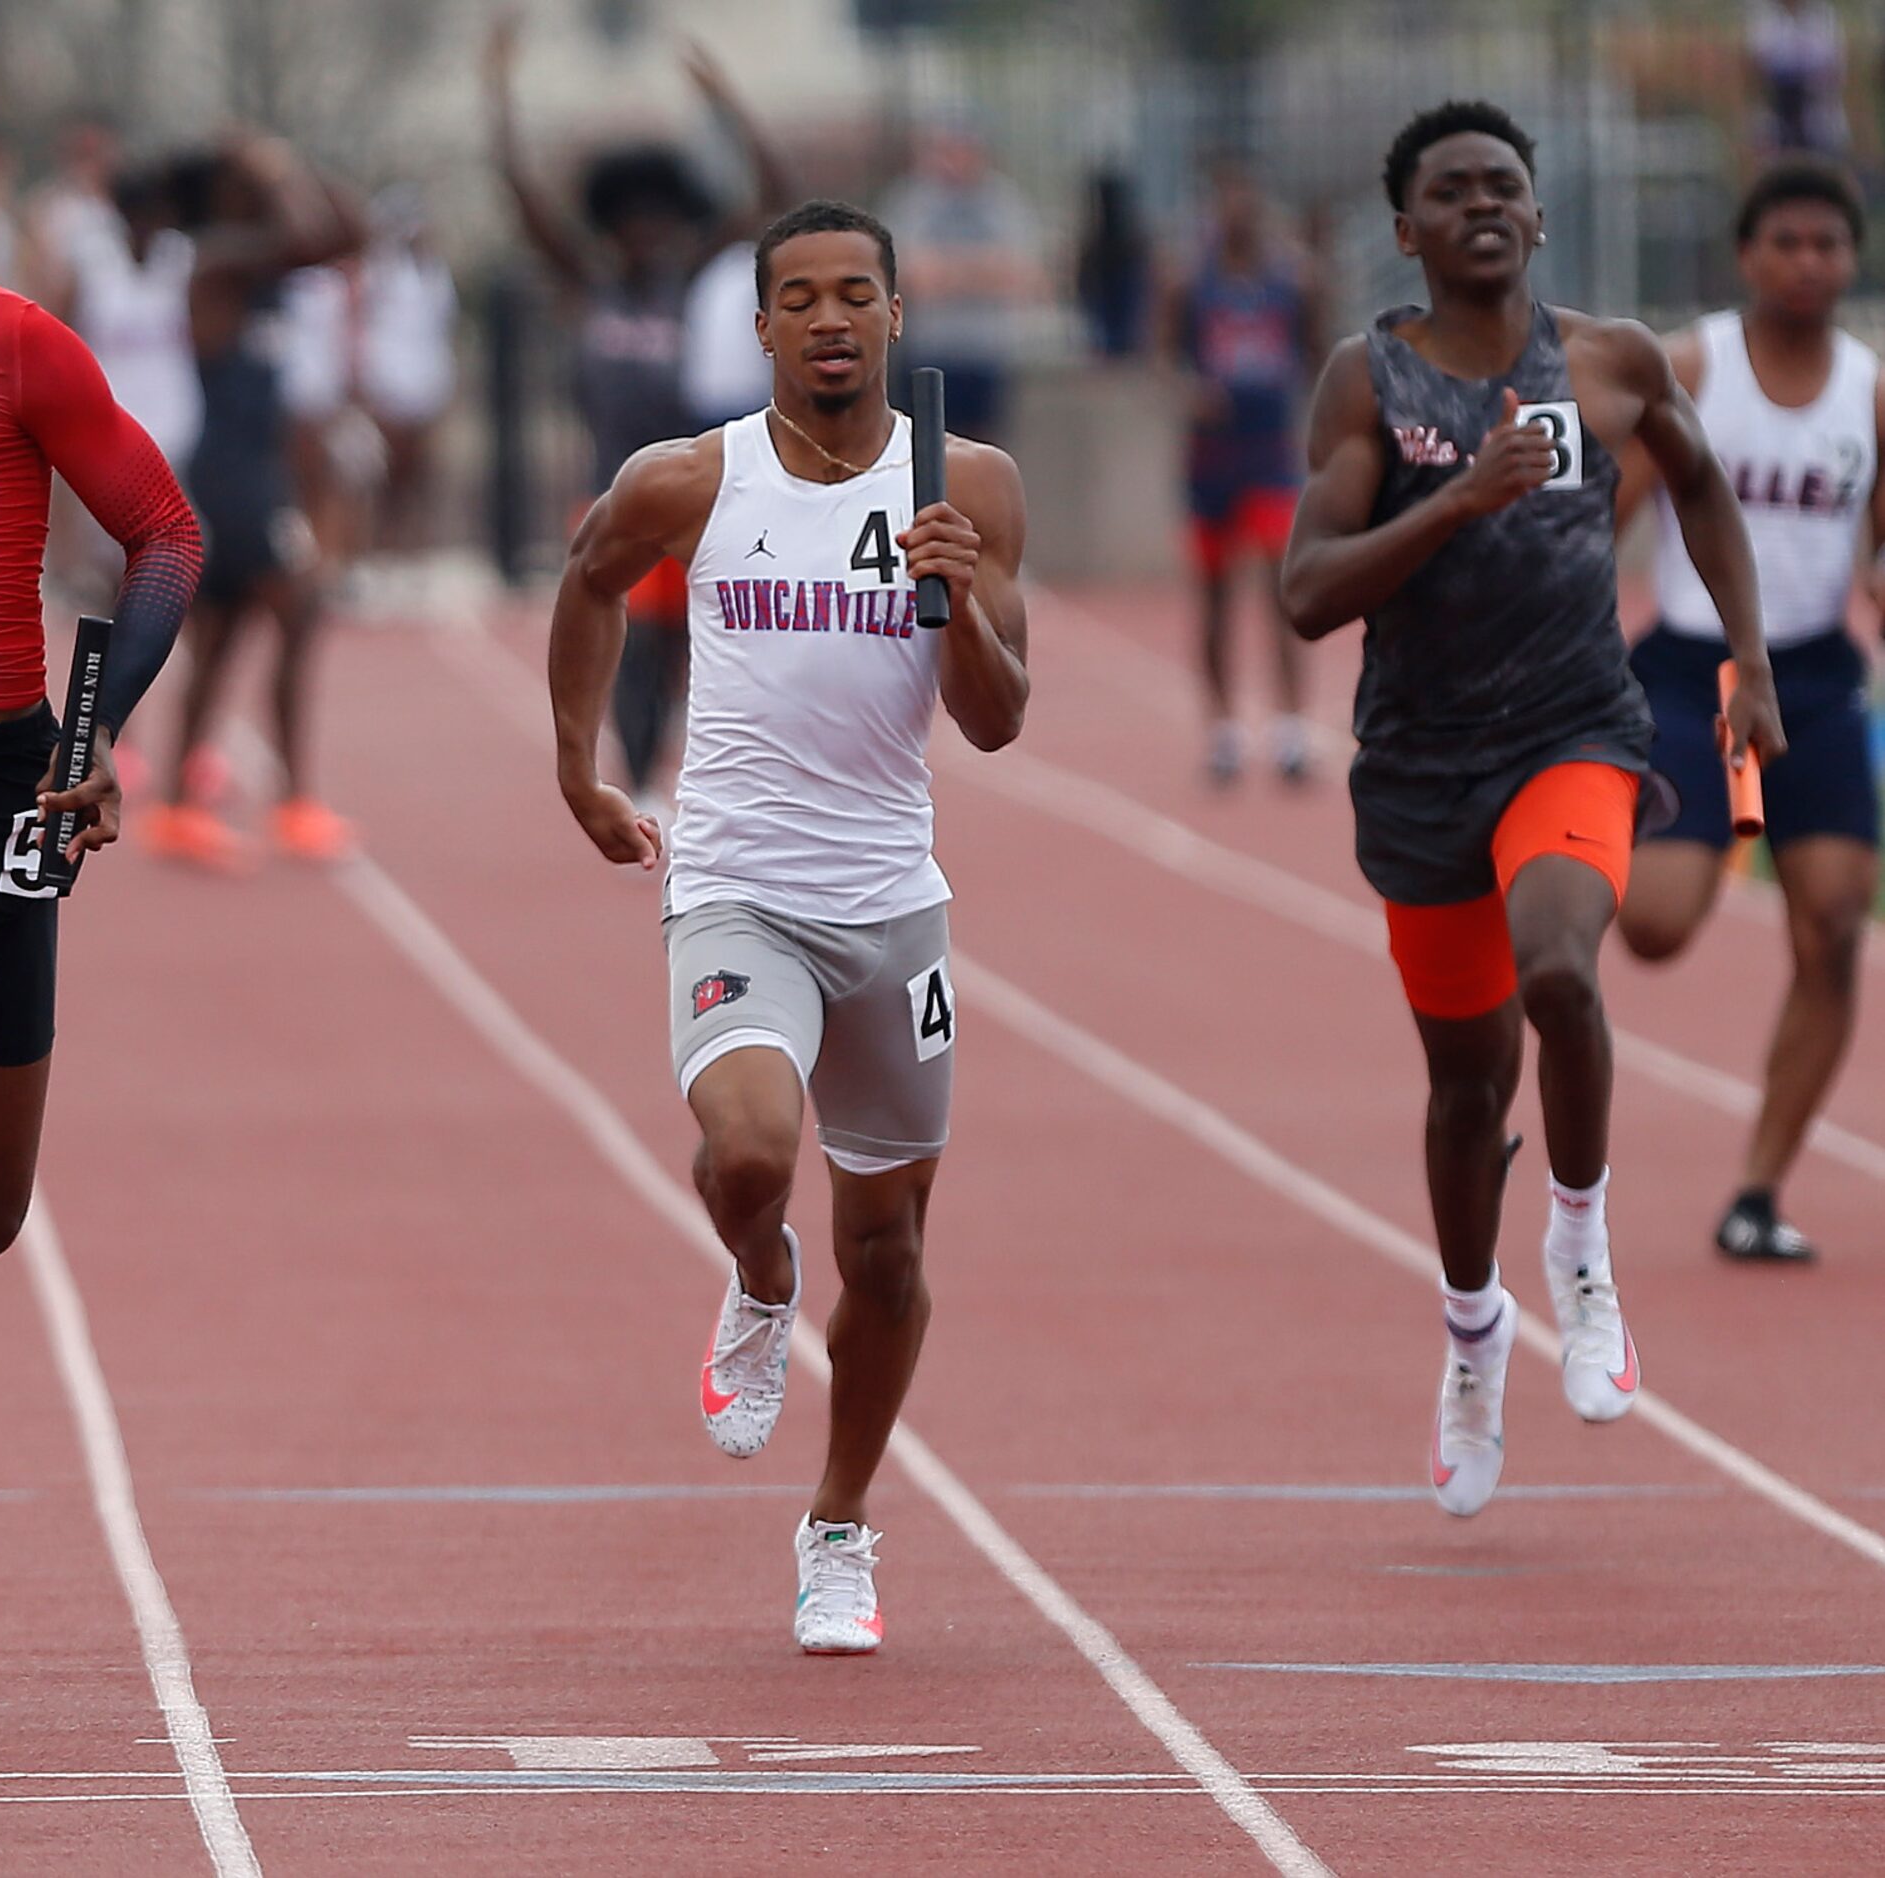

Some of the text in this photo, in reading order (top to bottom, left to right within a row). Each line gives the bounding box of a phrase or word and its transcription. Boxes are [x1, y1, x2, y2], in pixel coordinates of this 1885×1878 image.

[851, 509, 900, 584] 4
[716, 579, 917, 639] DUNCANVILLE
[57, 651, 102, 855] RUN TO BE REMEERED
[920, 967, 952, 1042] 4
